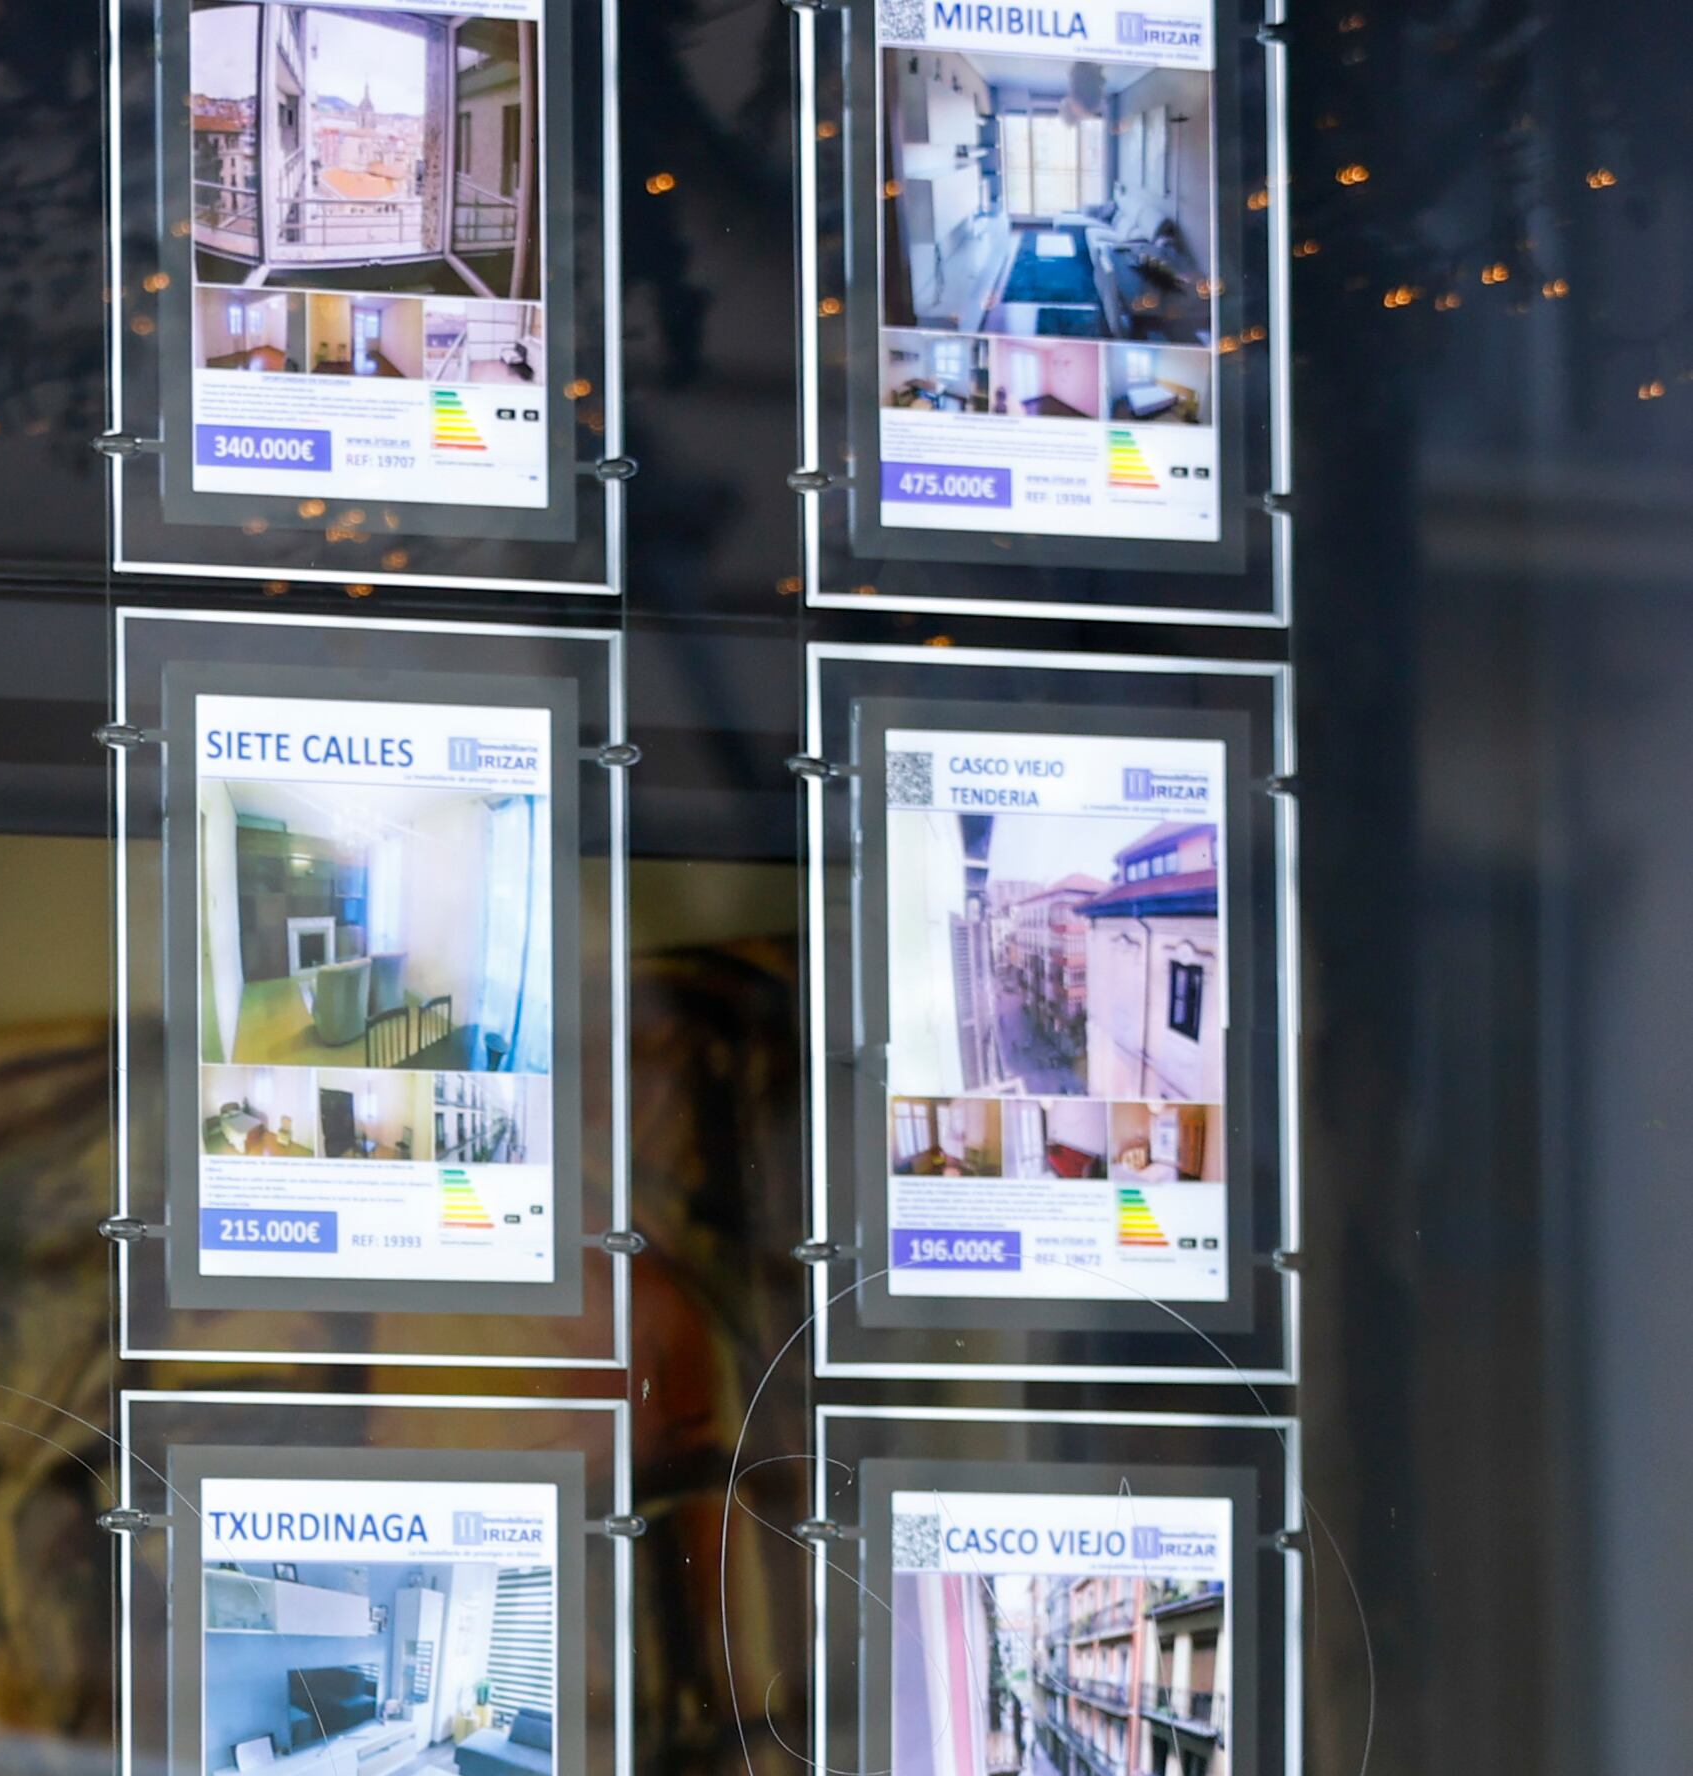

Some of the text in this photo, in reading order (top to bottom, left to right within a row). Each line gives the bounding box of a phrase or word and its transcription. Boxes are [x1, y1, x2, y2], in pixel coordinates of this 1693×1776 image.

[934, 1, 1087, 39] MIRIBILLA
[1144, 30, 1200, 45] IRIZAR
[215, 435, 314, 461] 340.000€
[346, 454, 415, 468] REF: 19707
[900, 473, 995, 498] 475.000€
[207, 730, 413, 767] SIETE CALLES
[477, 754, 537, 770] IRIZAR
[949, 757, 1064, 777] CASCO VIEJO
[950, 787, 1039, 806] TENDERIA
[1151, 785, 1207, 799] IRIZAR
[221, 1219, 320, 1243] 215.000€
[352, 1234, 421, 1248] REF: 19393
[909, 1239, 1005, 1263] 196.000€
[208, 1512, 428, 1542] TXURDINAGA
[482, 1528, 542, 1542] IRIZAR
[945, 1527, 1126, 1557] CASCO VIEJO
[1159, 1542, 1215, 1557] IRIZAR
